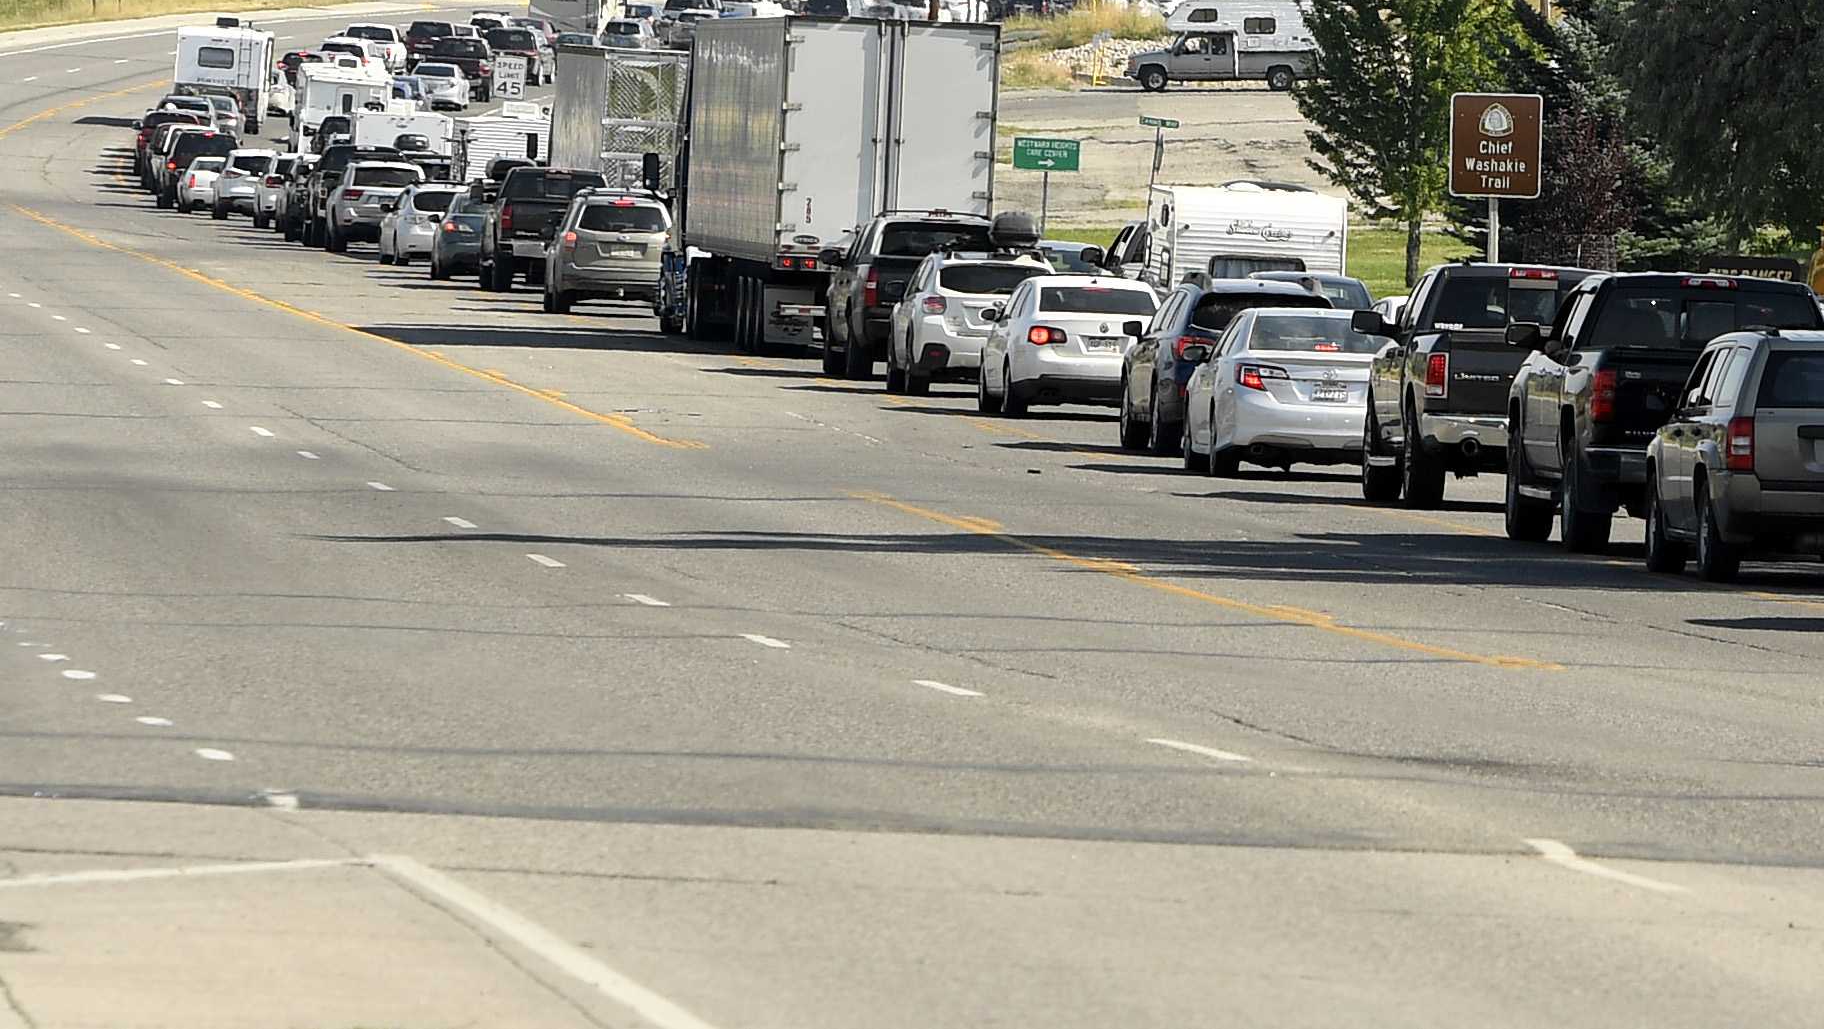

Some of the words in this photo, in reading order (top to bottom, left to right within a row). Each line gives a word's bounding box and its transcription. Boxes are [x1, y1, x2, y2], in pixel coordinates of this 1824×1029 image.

[496, 81, 521, 95] 45
[1479, 140, 1513, 154] Chief
[1465, 157, 1526, 172] Washakie
[1480, 175, 1510, 189] Trail
